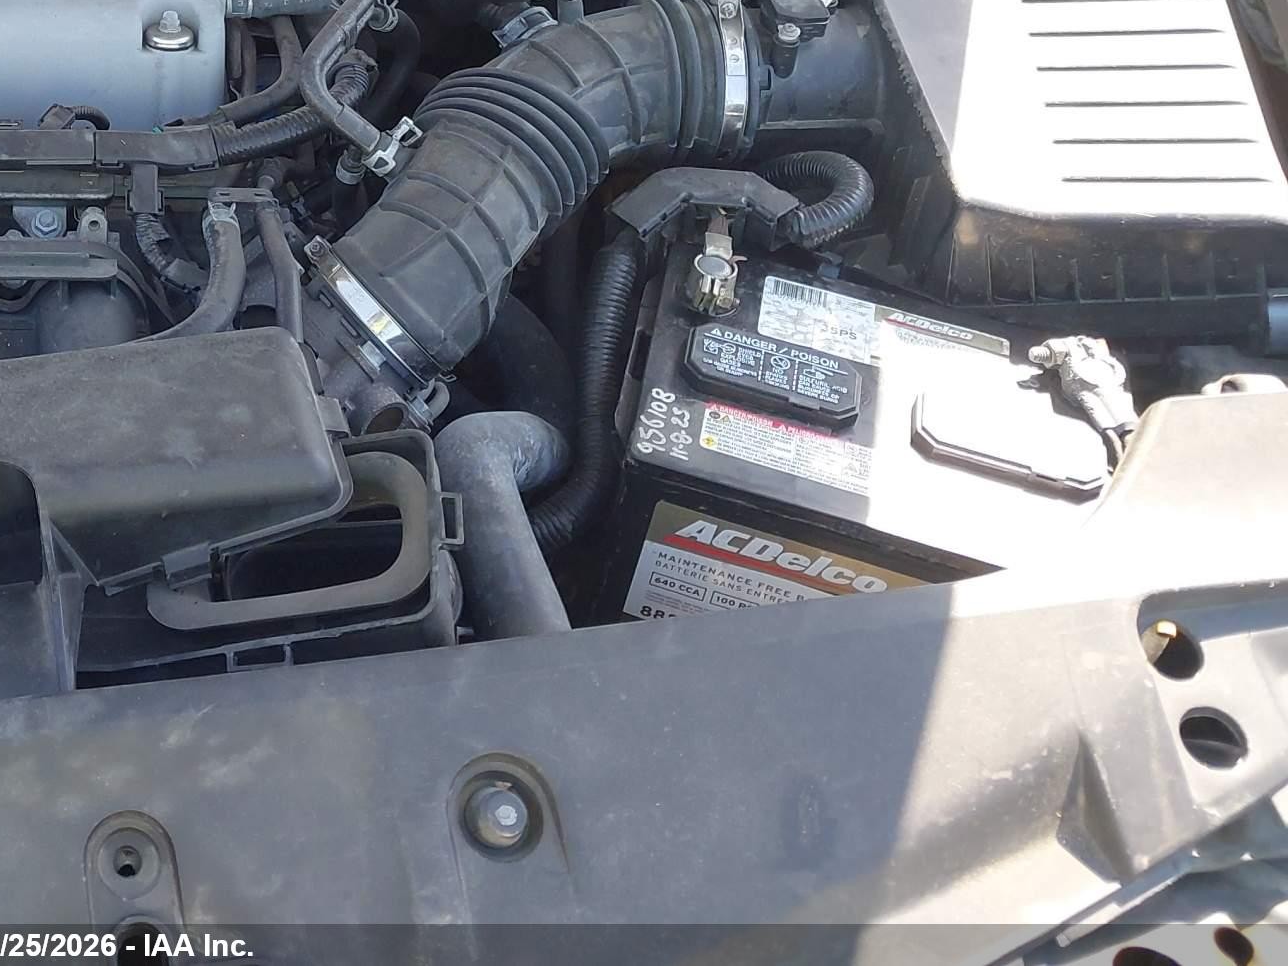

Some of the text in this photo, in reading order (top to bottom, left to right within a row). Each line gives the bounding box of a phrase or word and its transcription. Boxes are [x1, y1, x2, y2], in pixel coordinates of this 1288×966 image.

[887, 312, 973, 340] ACDelco
[723, 331, 777, 352] DANGER
[790, 348, 839, 370] POISON
[673, 519, 888, 593] ACDelco
[654, 577, 700, 596] 640 CCA
[655, 560, 708, 582] BATTERIE
[712, 578, 742, 592] SANS
[658, 551, 792, 597] MAINTENANCE FREE
[715, 596, 736, 606] 100
